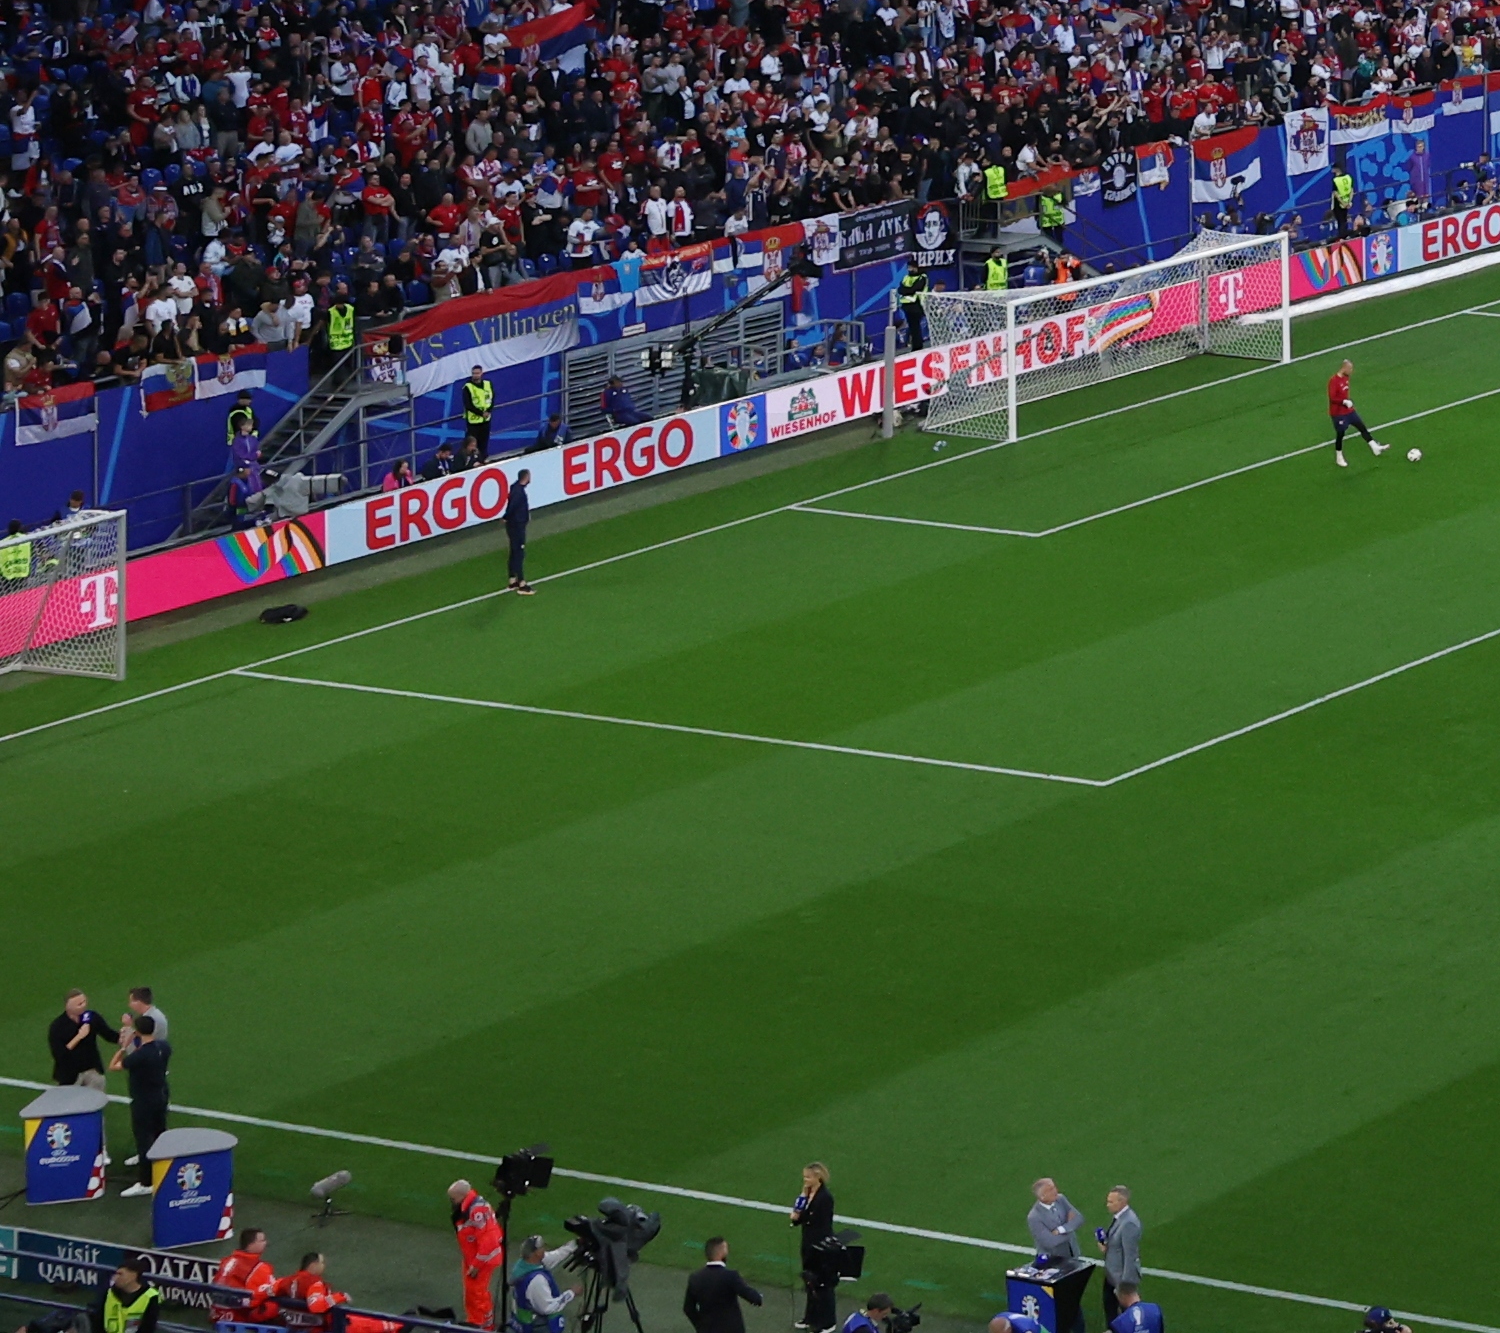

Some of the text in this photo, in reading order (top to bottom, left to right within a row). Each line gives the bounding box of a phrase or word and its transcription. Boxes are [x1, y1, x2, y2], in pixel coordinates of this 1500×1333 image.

[407, 300, 576, 364] VS Villingen
[770, 410, 837, 439] WIESENHOF
[563, 418, 695, 496] ERGO
[366, 469, 510, 550] ERGO
[58, 1242, 101, 1265] visit
